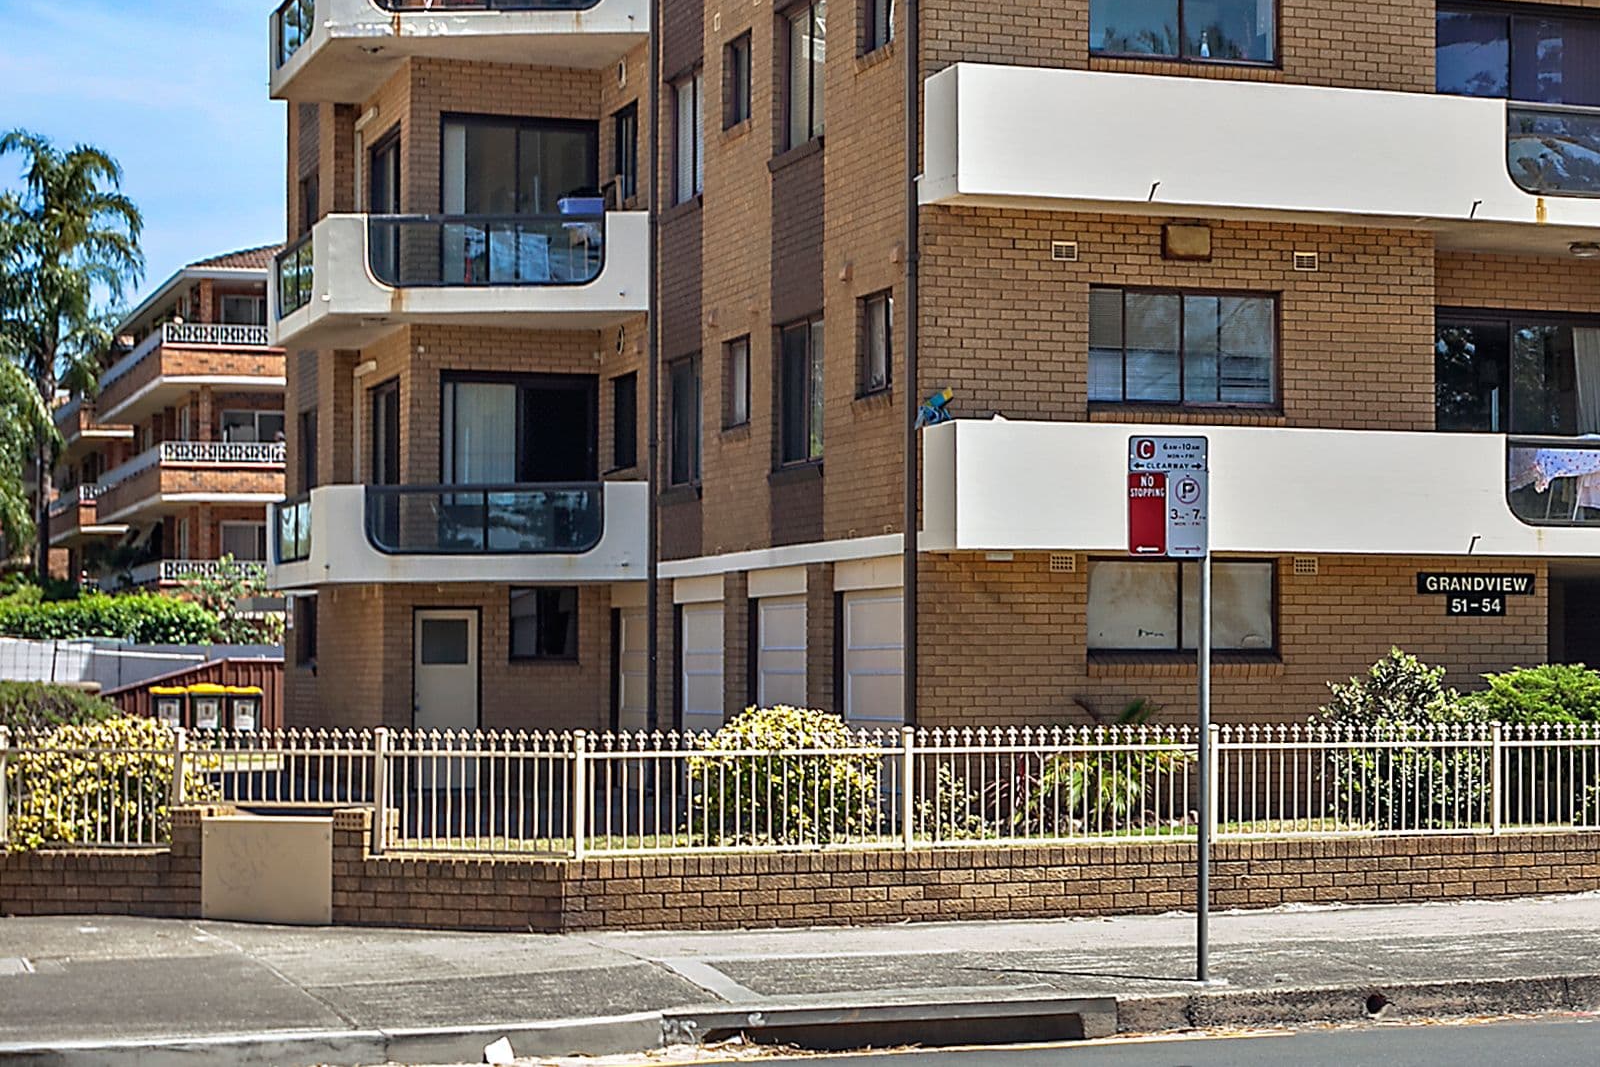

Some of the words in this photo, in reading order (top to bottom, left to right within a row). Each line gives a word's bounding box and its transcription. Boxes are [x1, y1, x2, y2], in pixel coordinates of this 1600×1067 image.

[1140, 441, 1151, 458] C
[1140, 475, 1154, 487] NO
[1130, 487, 1165, 497] STOPPING
[1426, 576, 1528, 592] GRANDVIEW
[1451, 598, 1501, 613] 51-54
